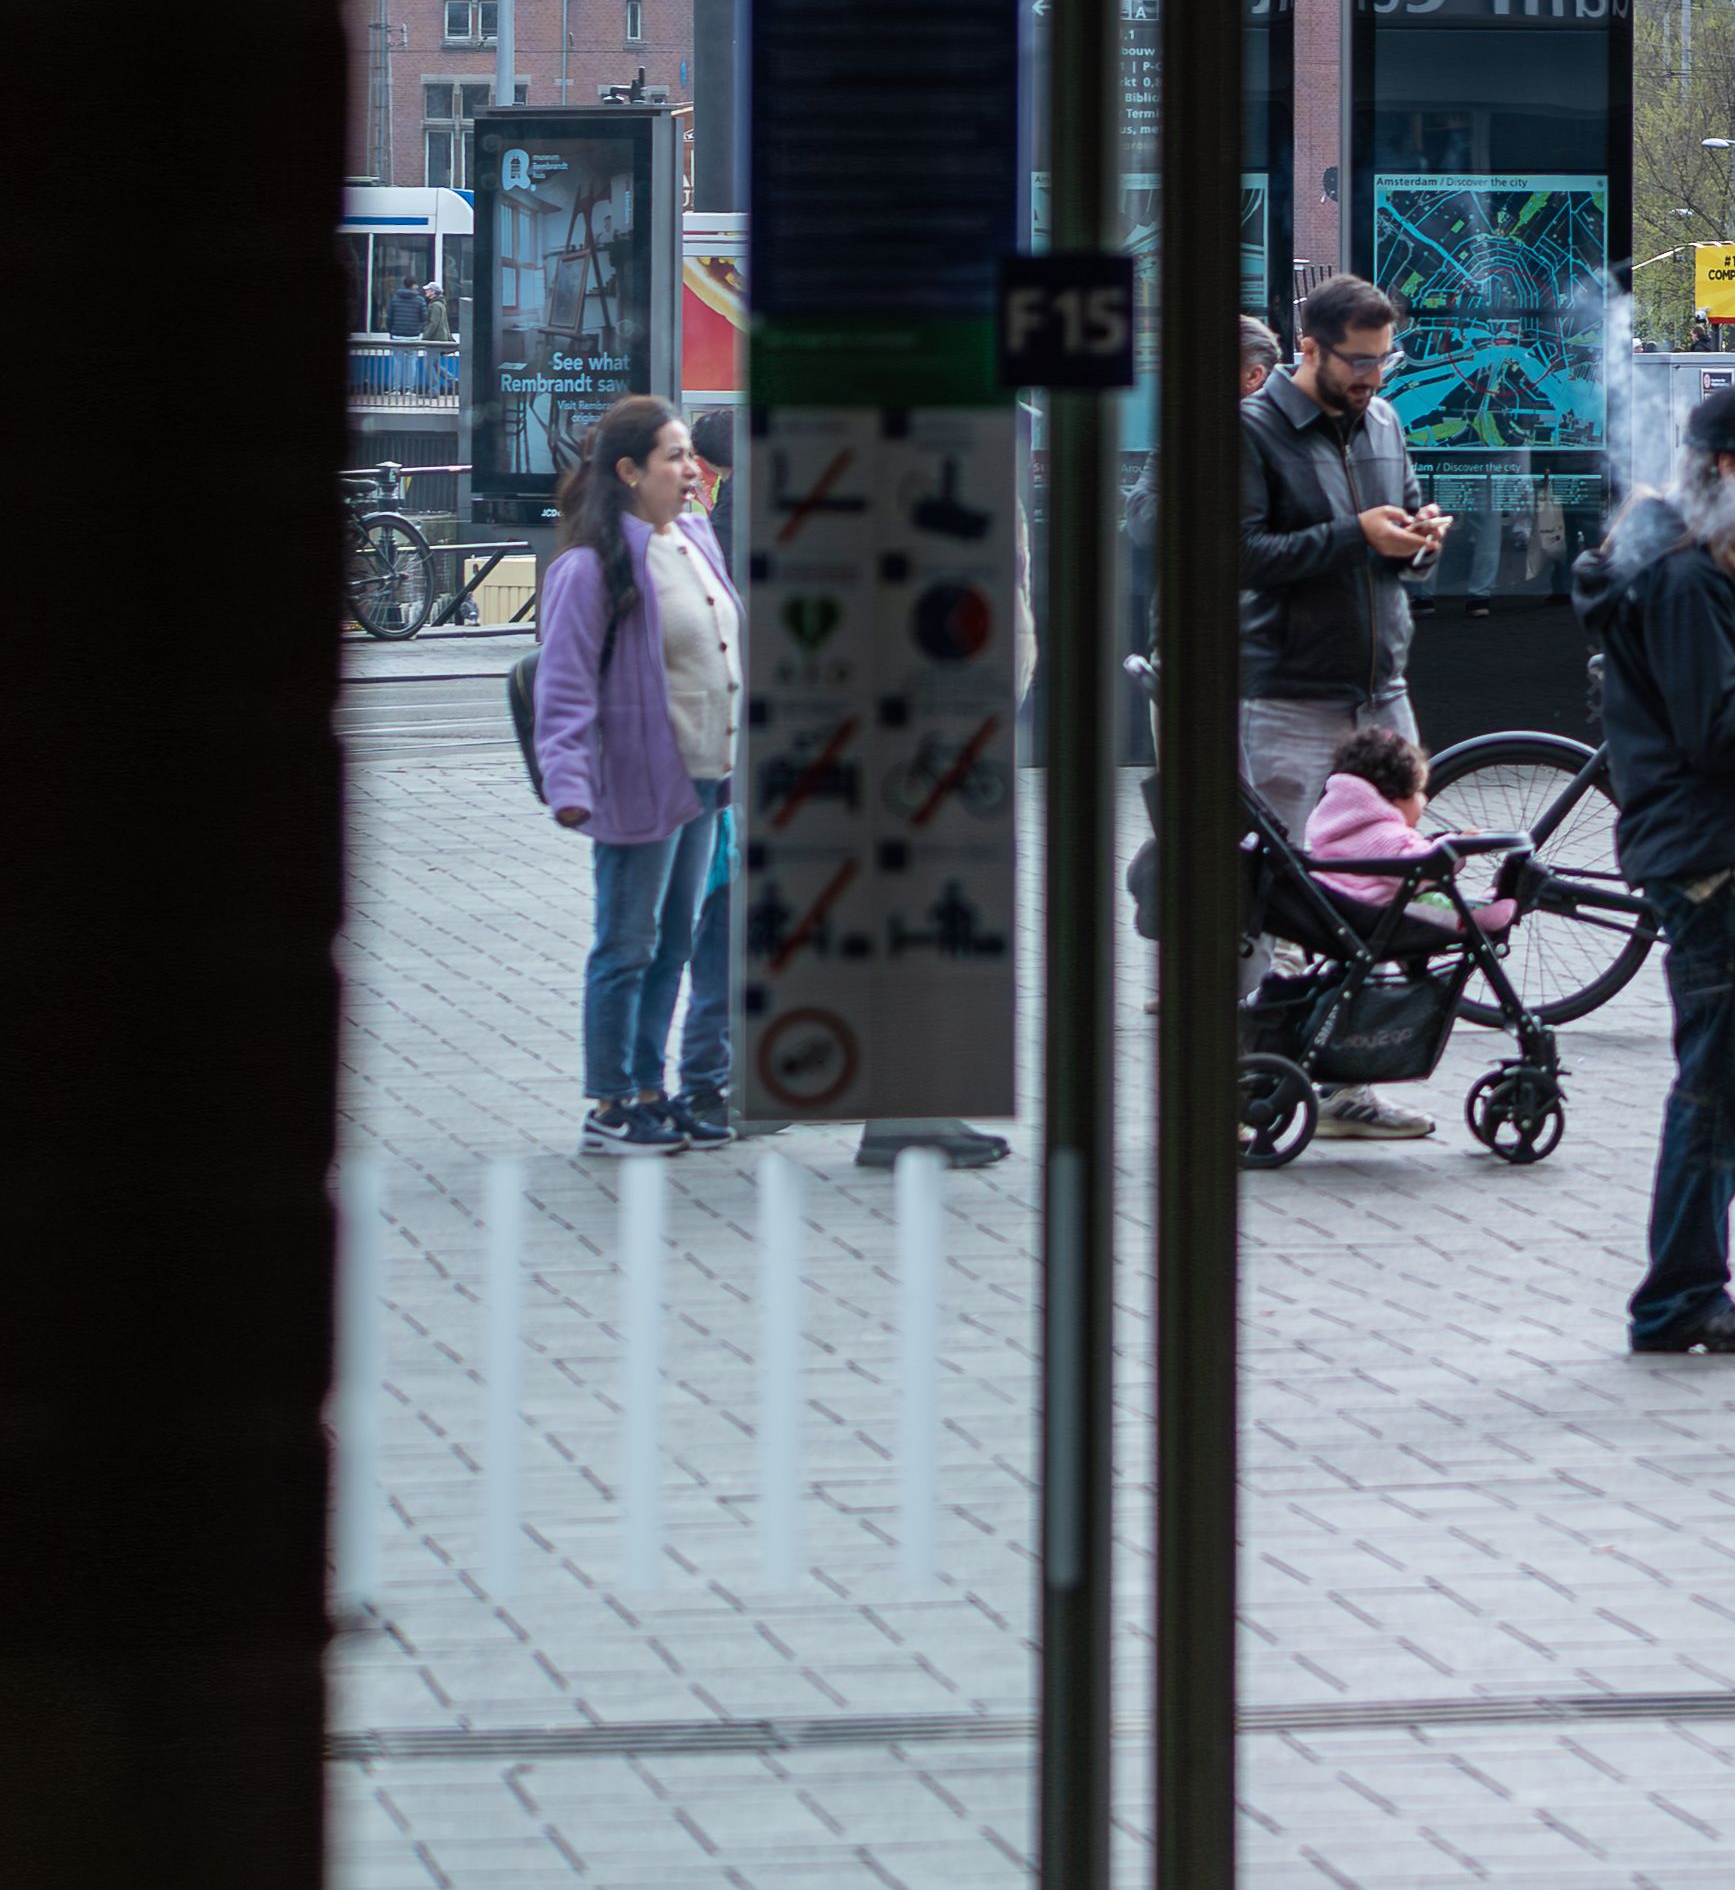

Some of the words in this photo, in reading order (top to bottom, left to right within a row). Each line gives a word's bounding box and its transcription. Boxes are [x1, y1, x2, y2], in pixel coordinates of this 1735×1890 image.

[1376, 177, 1437, 186] Amsterdam
[1446, 177, 1487, 187] Discover
[1490, 177, 1508, 187] the
[1510, 177, 1528, 189] city
[1006, 285, 1127, 356] F15
[552, 352, 585, 371] See
[588, 352, 631, 371] what
[501, 373, 592, 393] Rembrandt
[597, 376, 630, 393] saw
[557, 400, 577, 411] Visit
[1443, 462, 1484, 472] Discover
[1485, 462, 1502, 472] the
[1503, 462, 1521, 473] city
